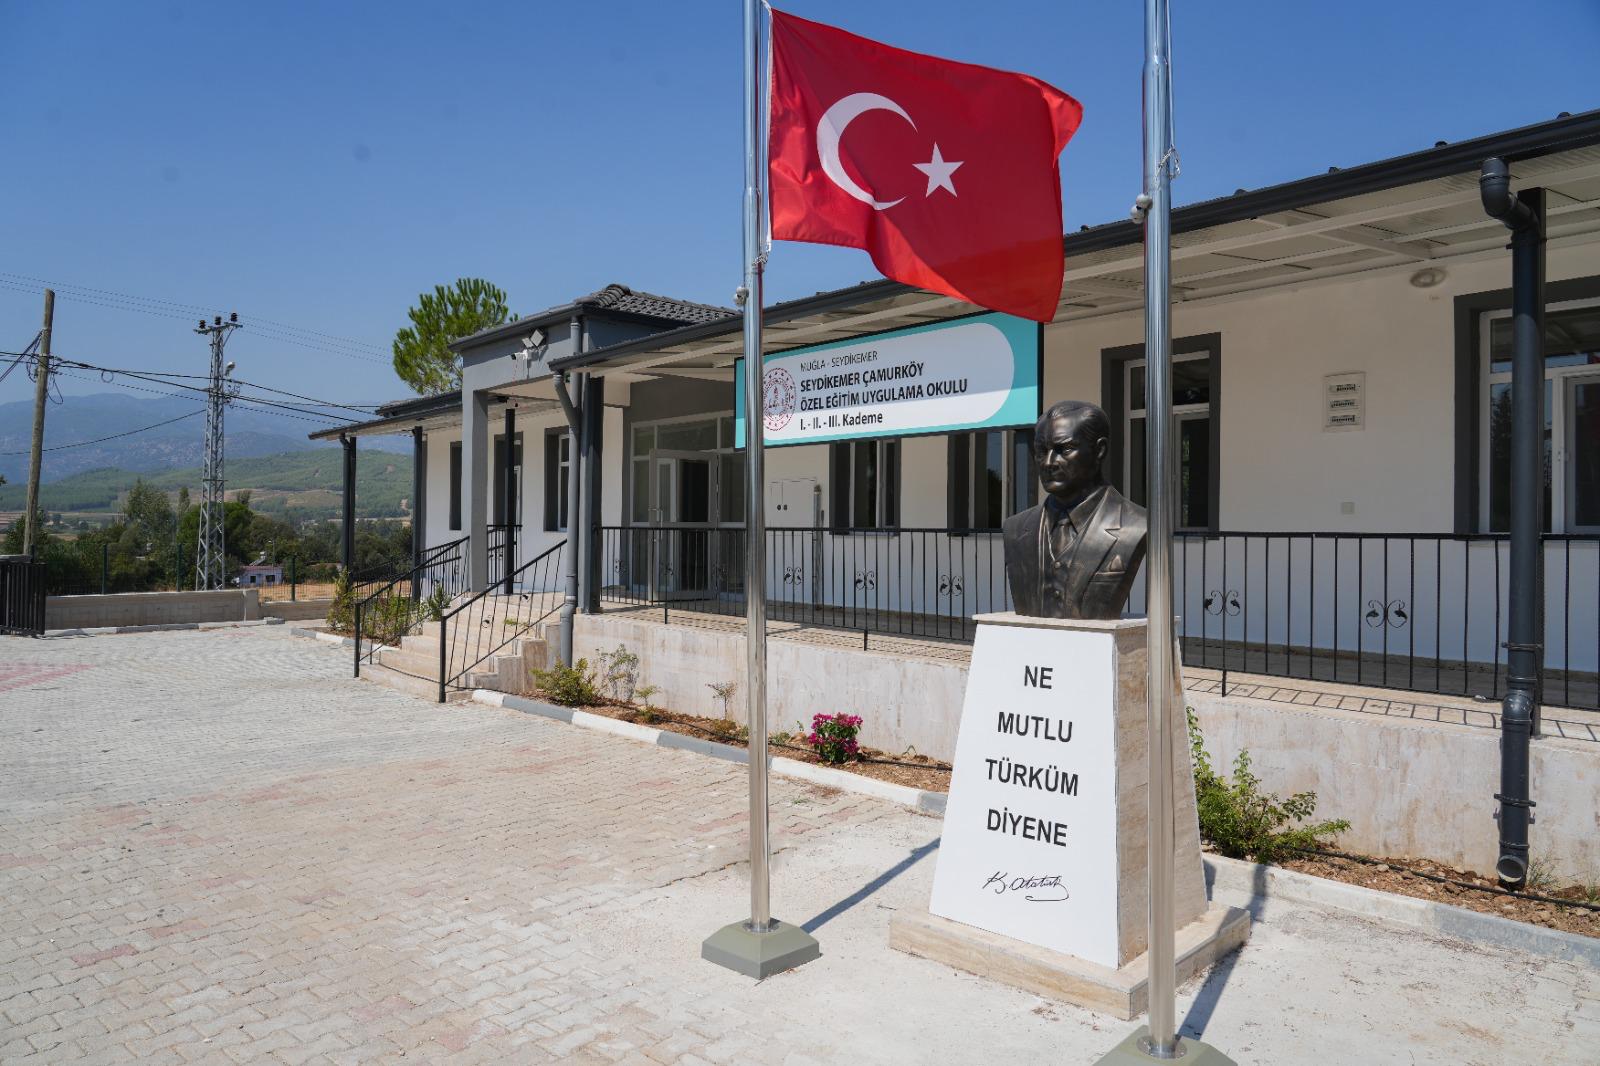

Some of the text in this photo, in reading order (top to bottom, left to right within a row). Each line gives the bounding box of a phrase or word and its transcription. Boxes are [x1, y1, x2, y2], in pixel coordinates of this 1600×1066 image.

[832, 351, 878, 367] SEYDİKEMER
[801, 361, 923, 392] SEYDİKEMER ÇAMURKÖY
[801, 379, 967, 411] ÖZEL EĞİTİM UYGULAMA OKULU
[843, 412, 882, 426] Kademe
[1024, 665, 1053, 689] NE
[997, 711, 1073, 742] MUTLU
[985, 757, 1079, 796] TÜRKÜM
[987, 807, 1068, 847] DİYENE
